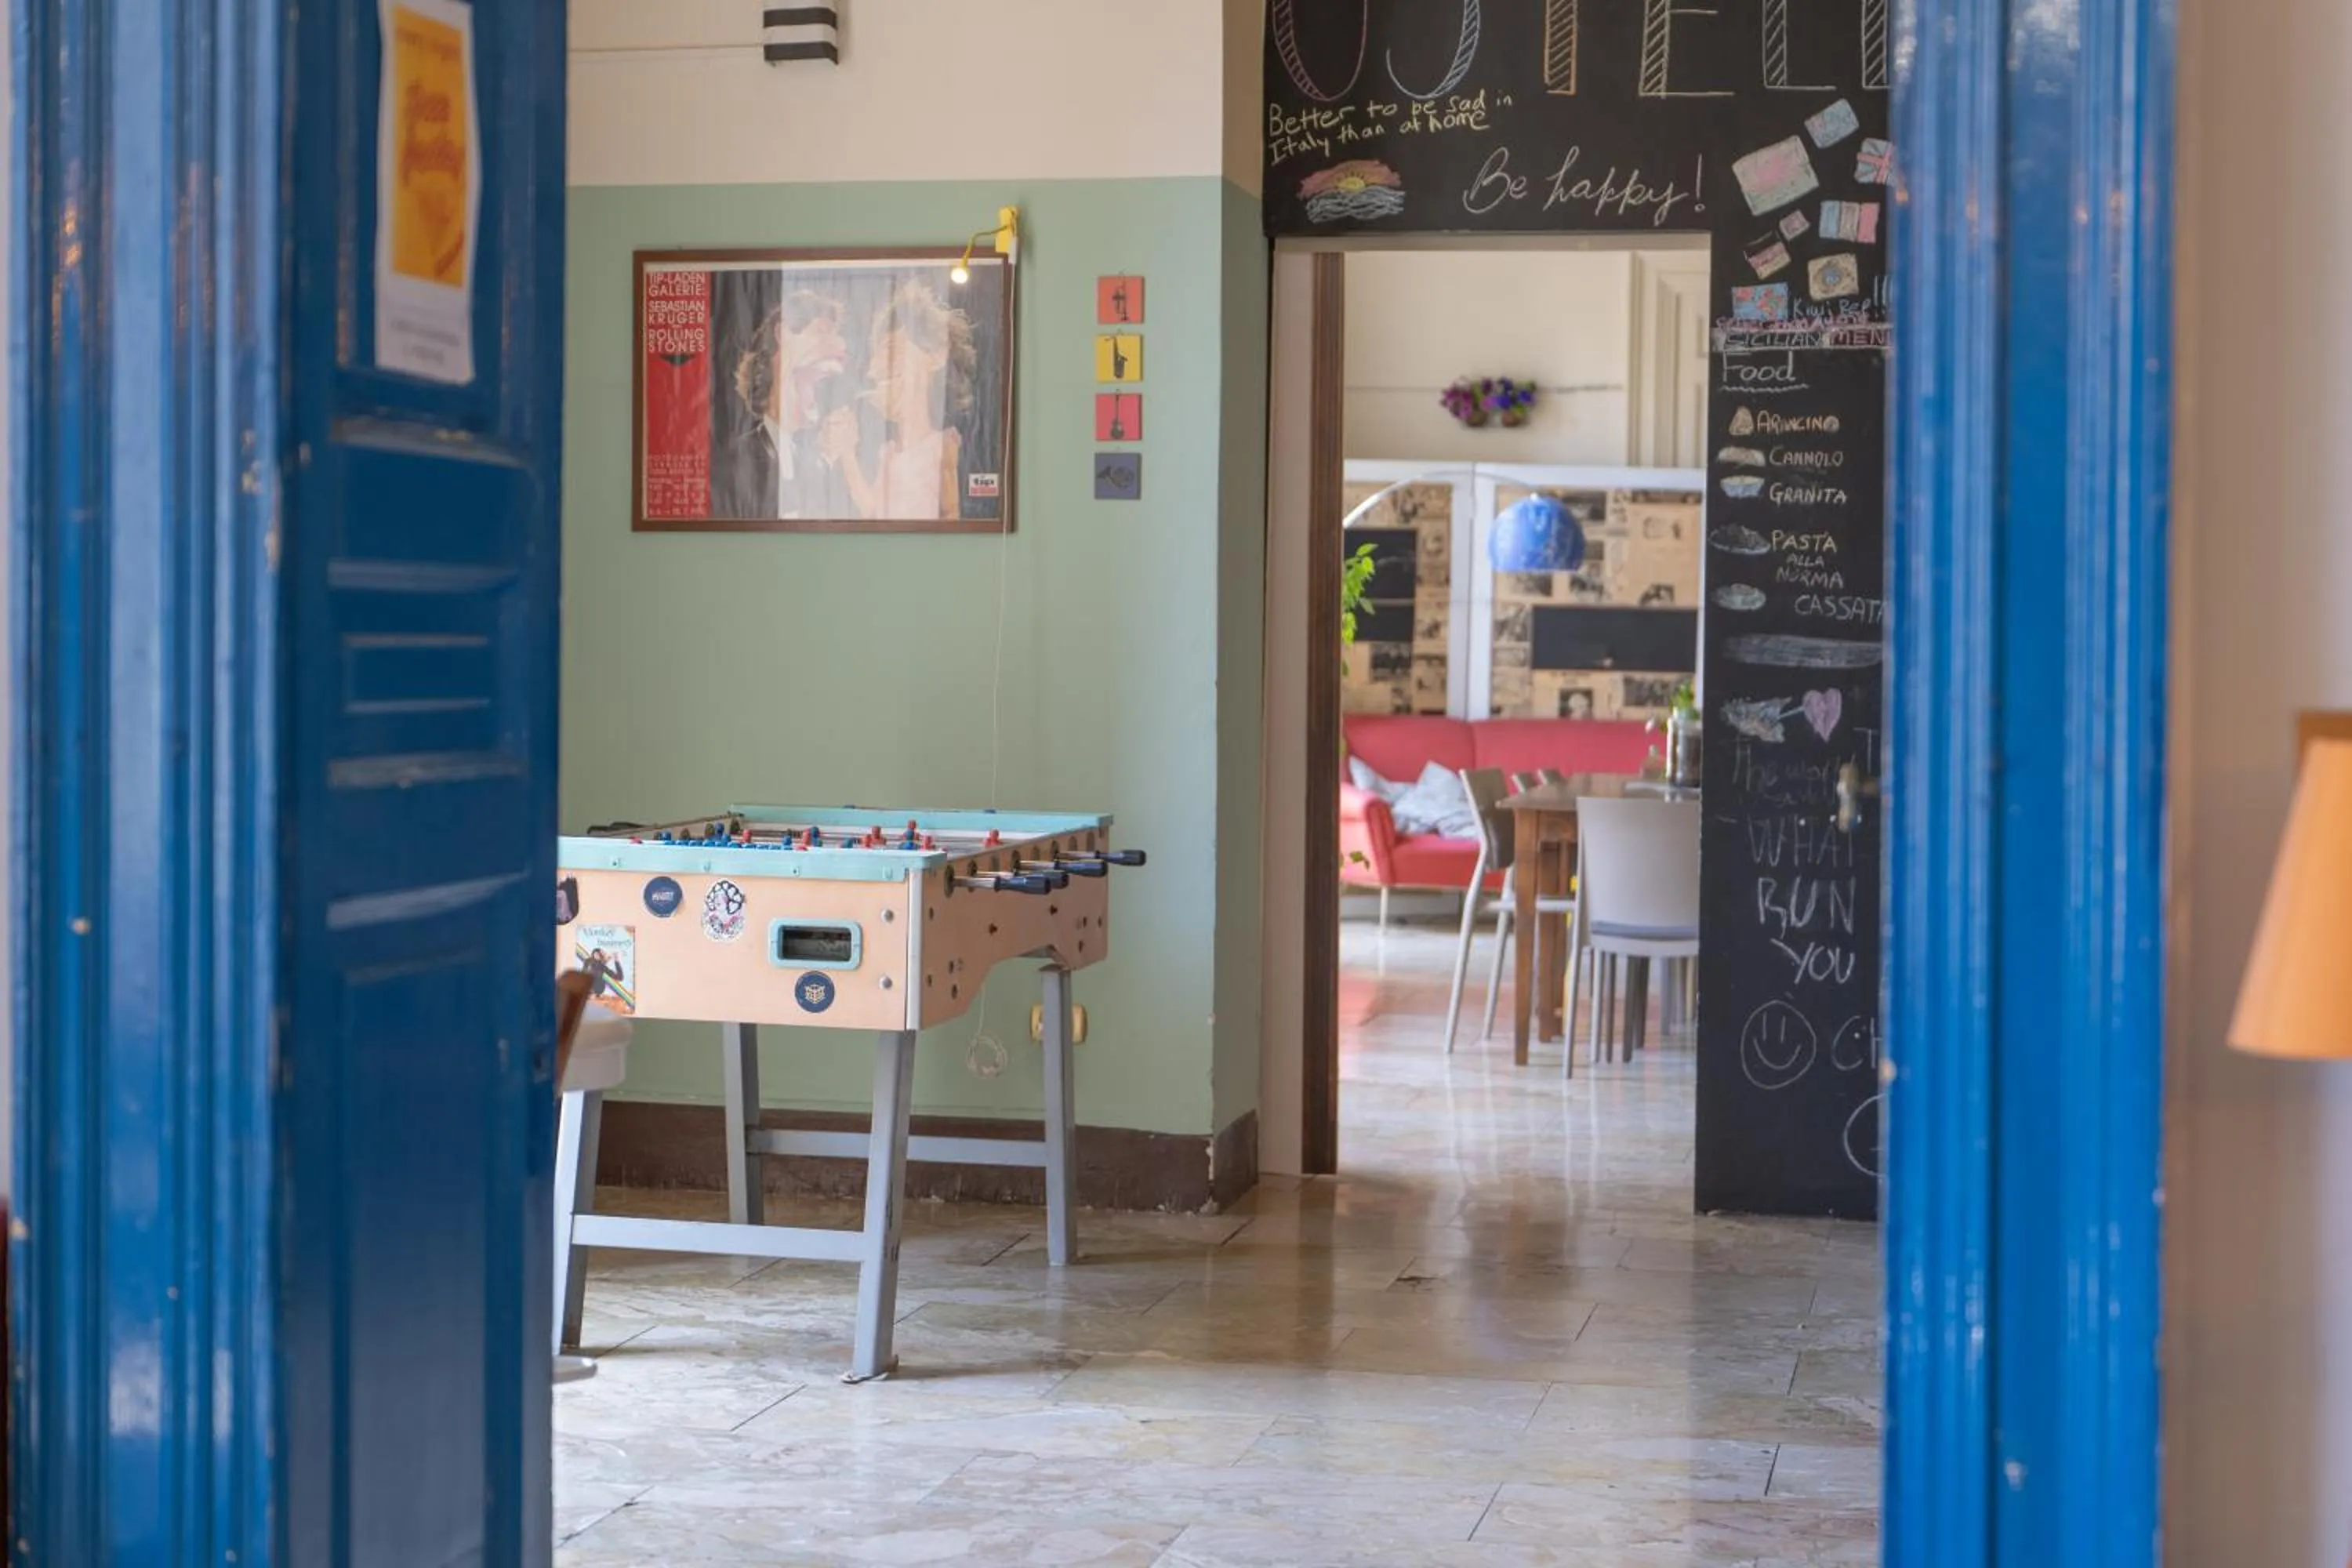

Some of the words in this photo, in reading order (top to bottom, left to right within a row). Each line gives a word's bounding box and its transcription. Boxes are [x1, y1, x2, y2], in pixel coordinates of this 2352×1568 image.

[1269, 103, 1356, 136] Better
[1367, 100, 1398, 117] to
[1411, 98, 1437, 116] be
[1444, 89, 1486, 114] sad
[1496, 89, 1513, 107] in
[1269, 132, 1331, 166] Italy
[1337, 123, 1385, 143] than
[1399, 116, 1421, 134] at
[1428, 111, 1490, 133] home
[1463, 147, 1527, 214] Be
[648, 300, 706, 313] SEBASTIAN
[648, 328, 705, 340] ROLLING
[1726, 331, 1823, 346] SICILIAN
[648, 340, 706, 353] STONES
[1722, 350, 1796, 382] Food
[1769, 482, 1848, 505] GRANITA
[1771, 529, 1838, 553] PASTA
[1786, 554, 1825, 568] ALLA
[1776, 566, 1844, 589] NORMA
[1769, 938, 1856, 985] YOU
